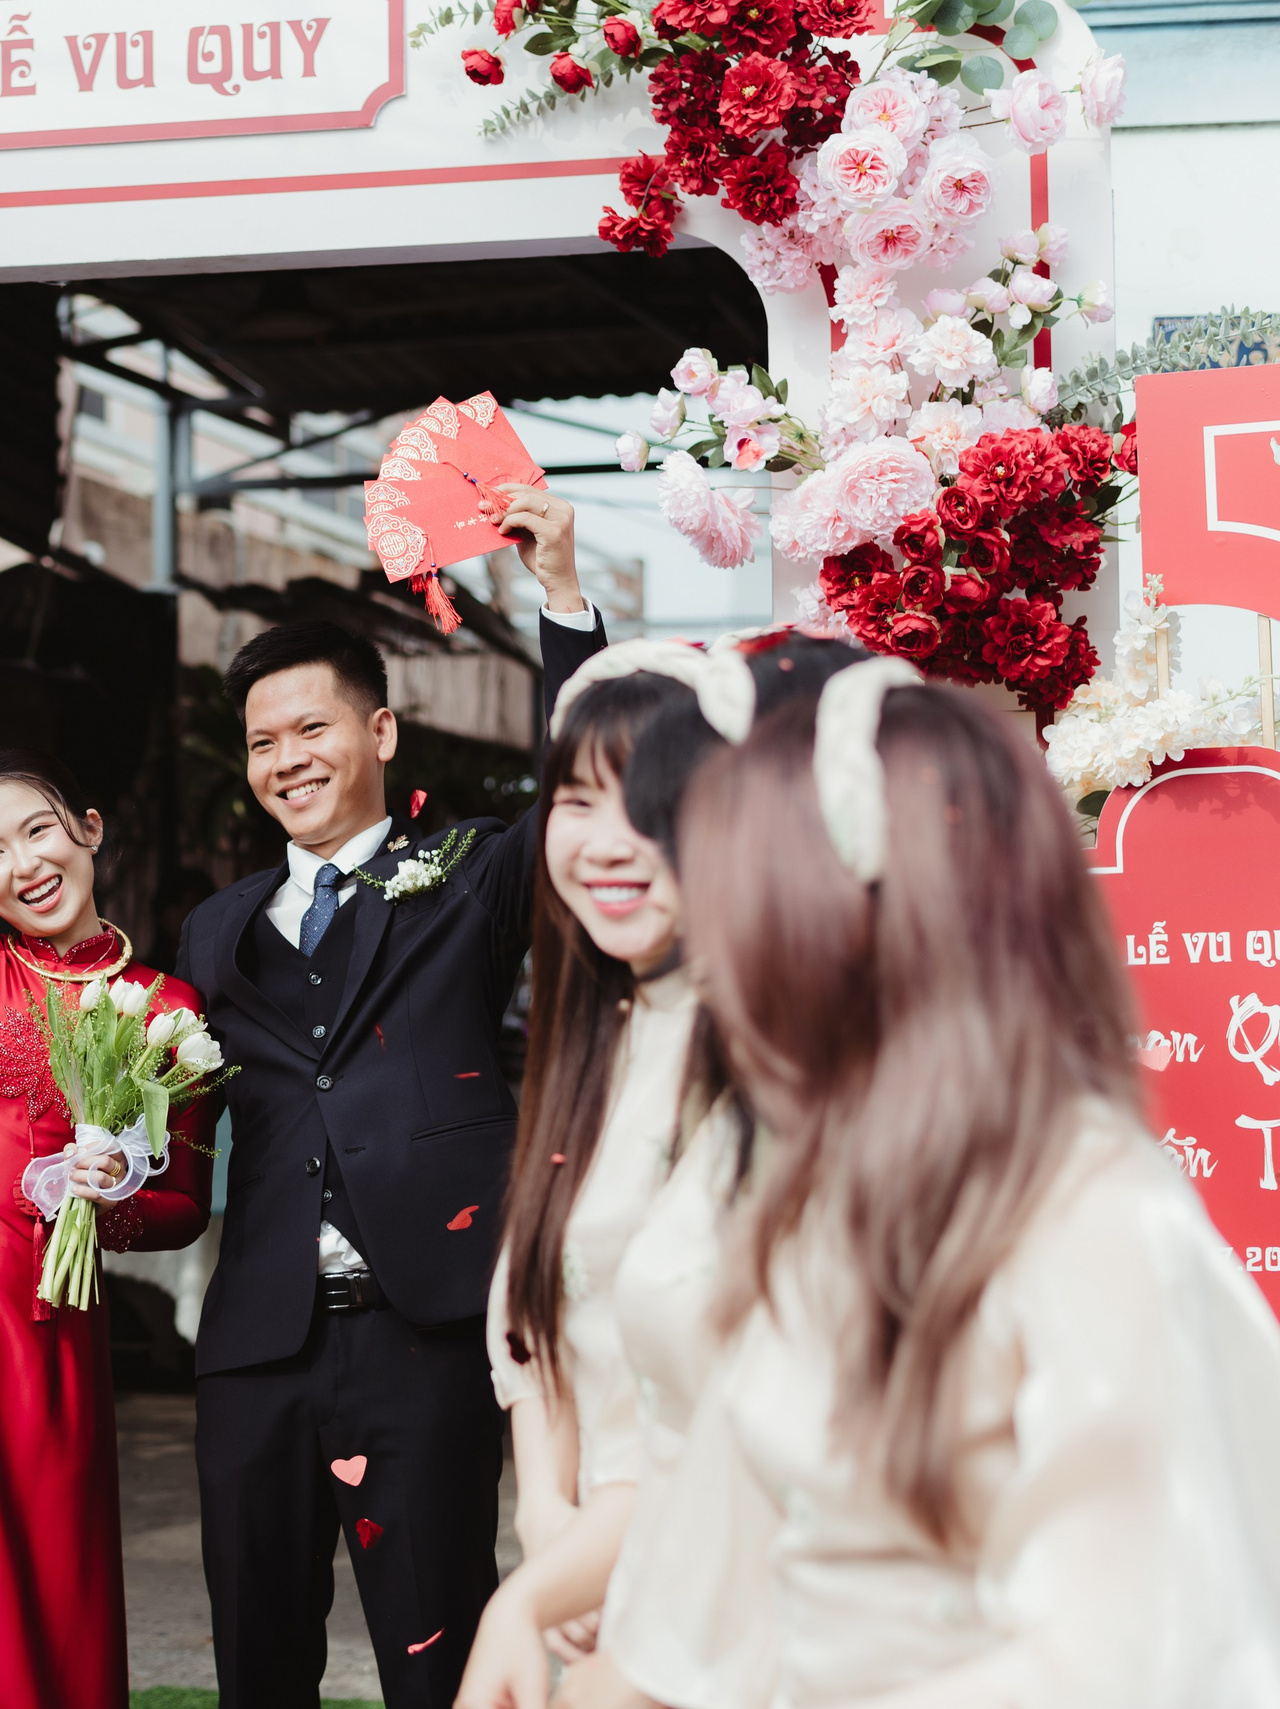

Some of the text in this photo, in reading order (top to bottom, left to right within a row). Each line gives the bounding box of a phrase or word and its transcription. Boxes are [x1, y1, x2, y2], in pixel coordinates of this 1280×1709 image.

[64, 29, 157, 93] VU
[186, 17, 332, 97] QUY
[1126, 920, 1171, 966] LỄ
[1182, 930, 1233, 964] VU
[1226, 993, 1280, 1087] Q
